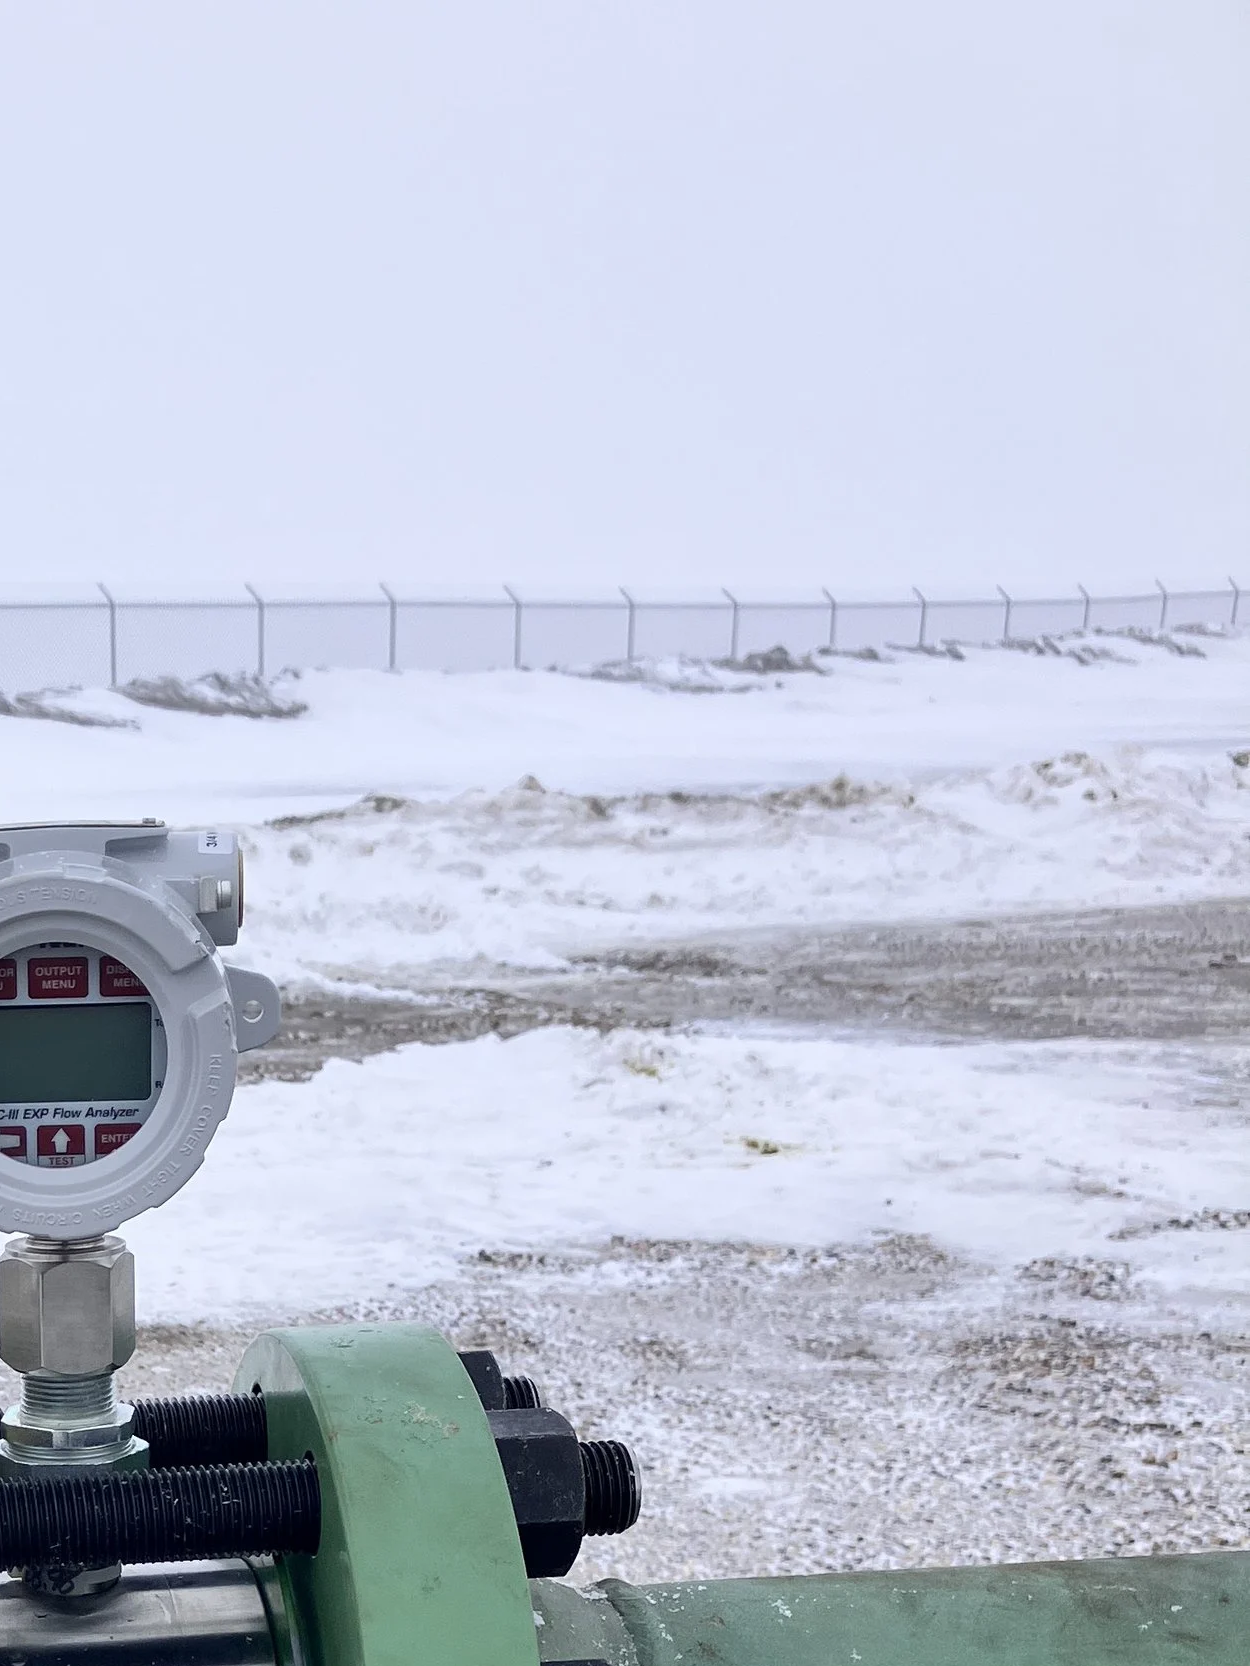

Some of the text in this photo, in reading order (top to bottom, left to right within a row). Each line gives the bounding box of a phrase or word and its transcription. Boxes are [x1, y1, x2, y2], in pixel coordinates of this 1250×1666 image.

[35, 965, 83, 977] OUTPUT
[41, 980, 76, 990] MENU
[22, 1108, 49, 1120] EXP
[53, 1107, 82, 1119] Flow
[85, 1106, 140, 1120] Analyzer
[48, 1156, 76, 1166] TEST
